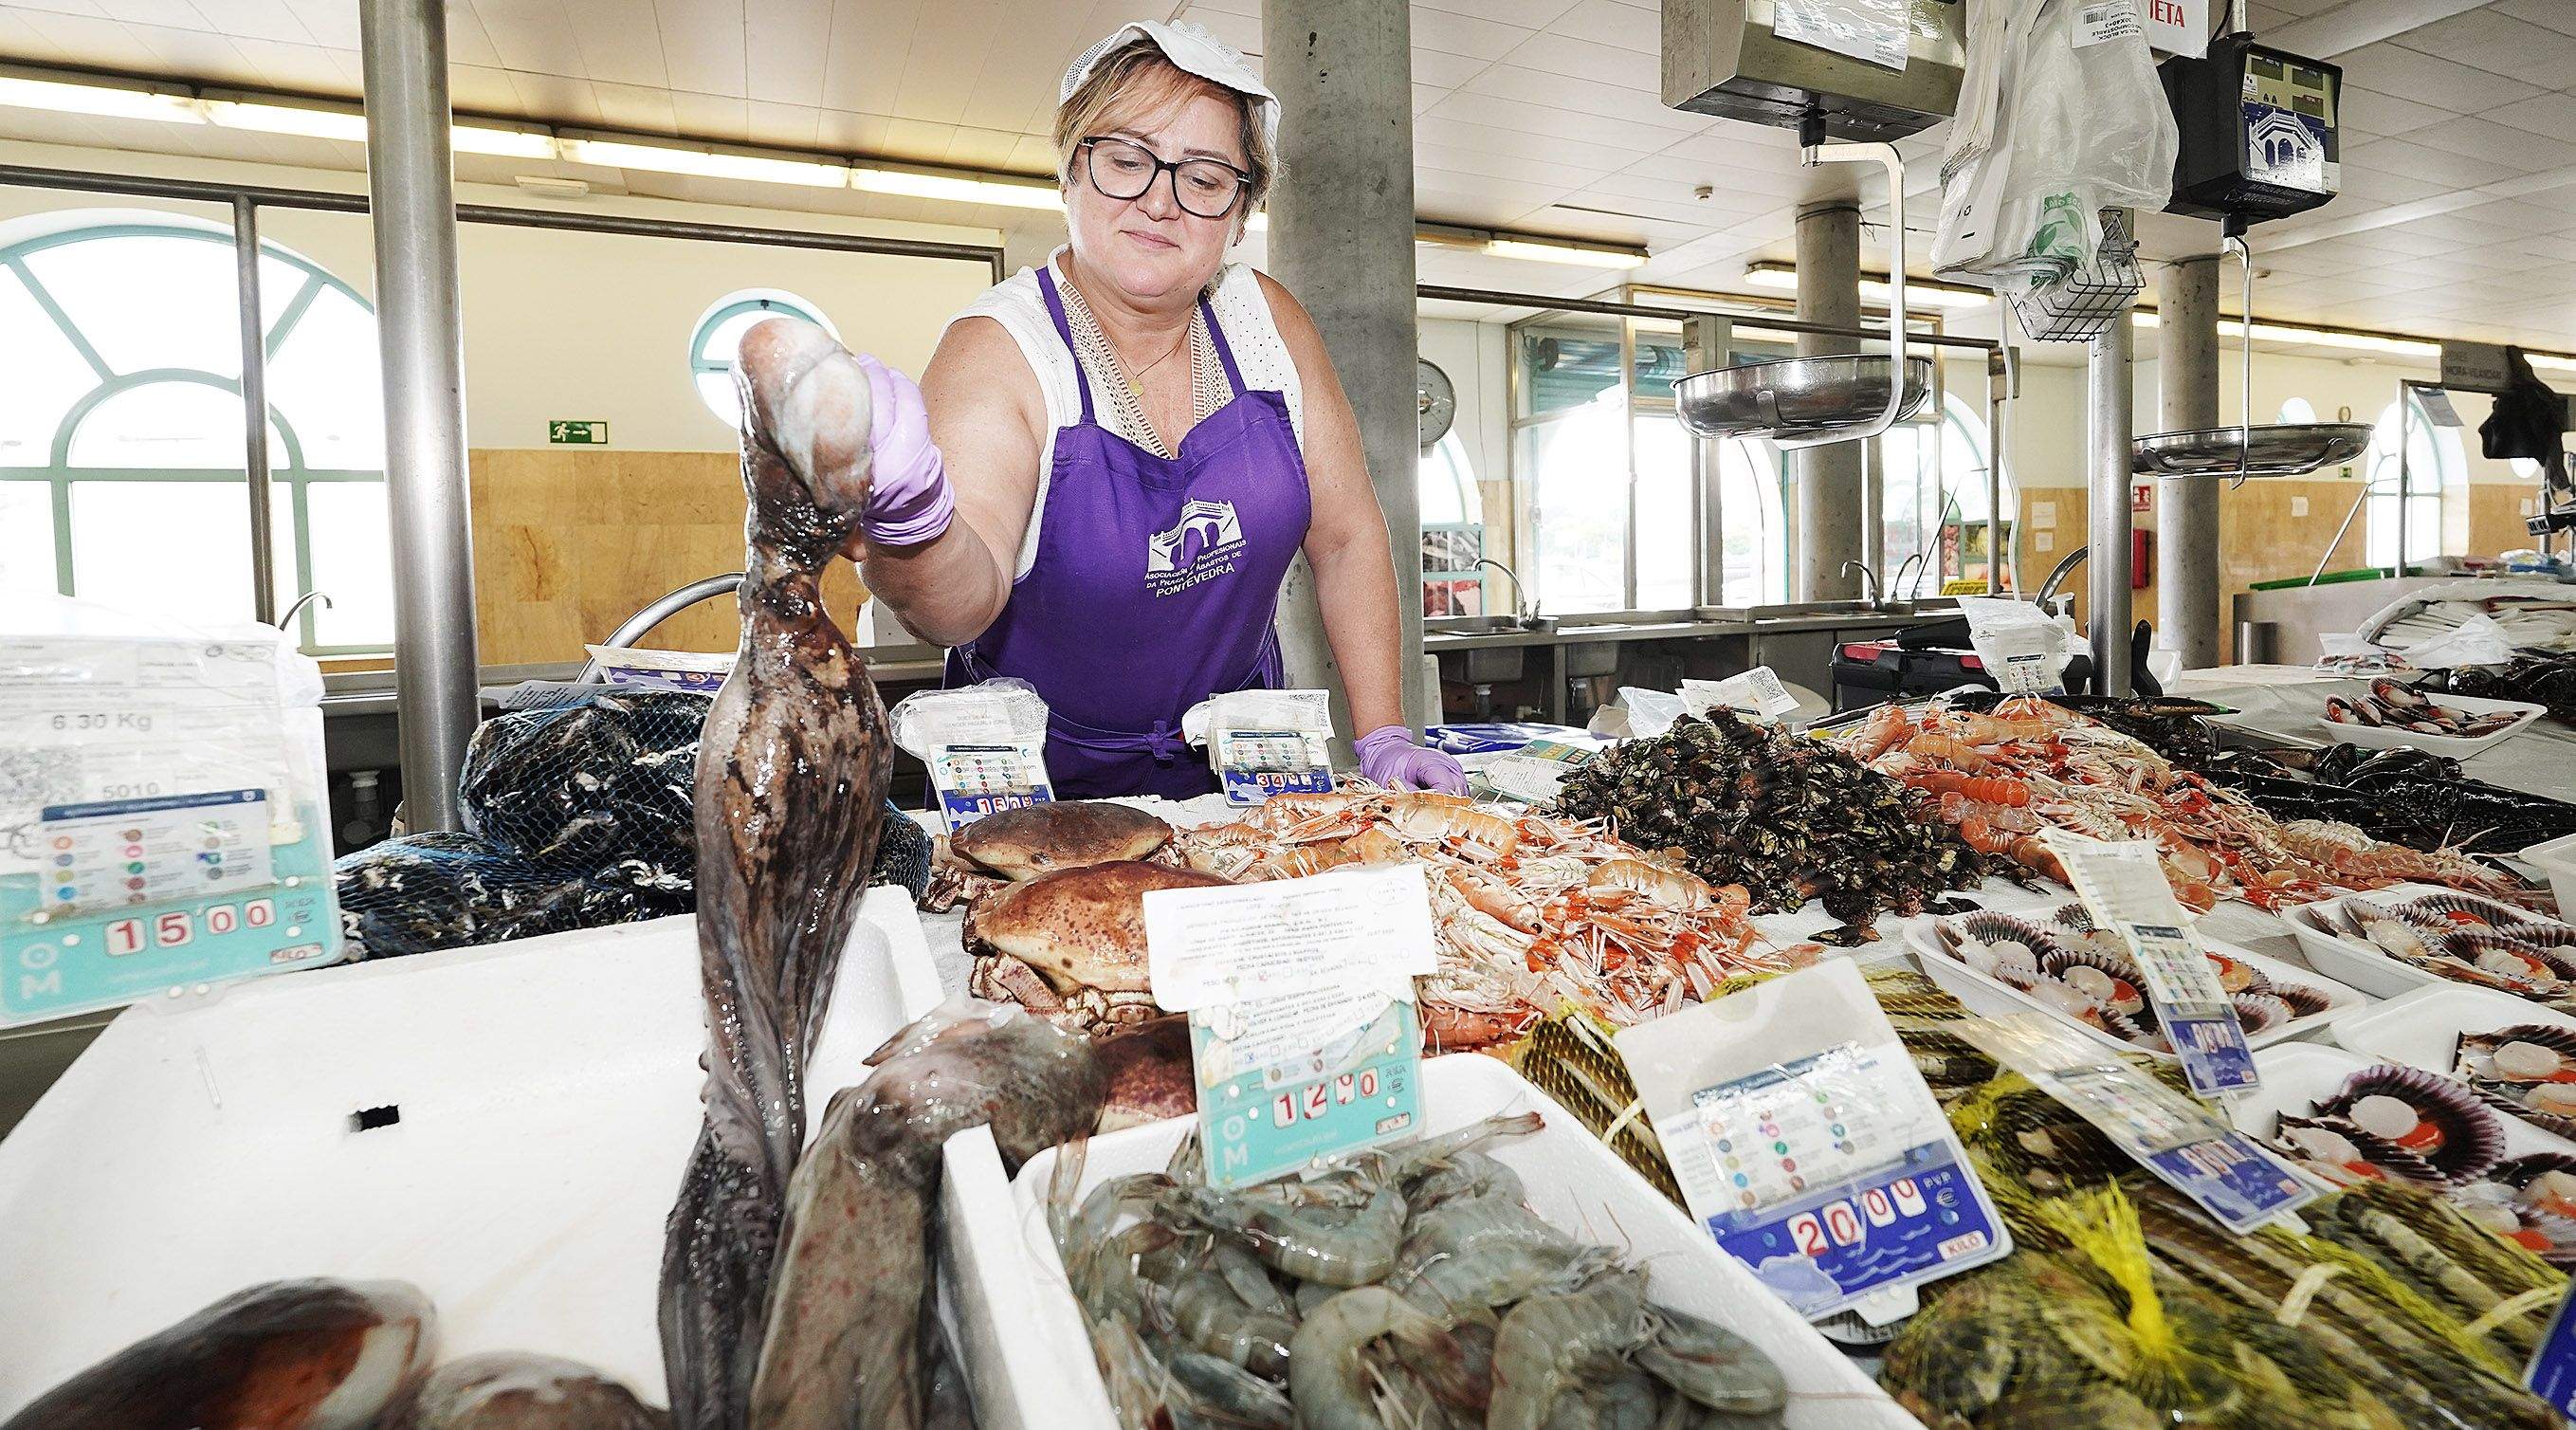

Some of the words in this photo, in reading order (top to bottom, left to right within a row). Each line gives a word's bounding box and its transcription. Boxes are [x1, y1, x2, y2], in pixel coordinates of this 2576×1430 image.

[1197, 540, 1247, 561] PROFESIONAIS
[1196, 555, 1230, 571] ABASTOS
[1157, 562, 1235, 597] PONTEVEDRA
[118, 711, 153, 732] Kg
